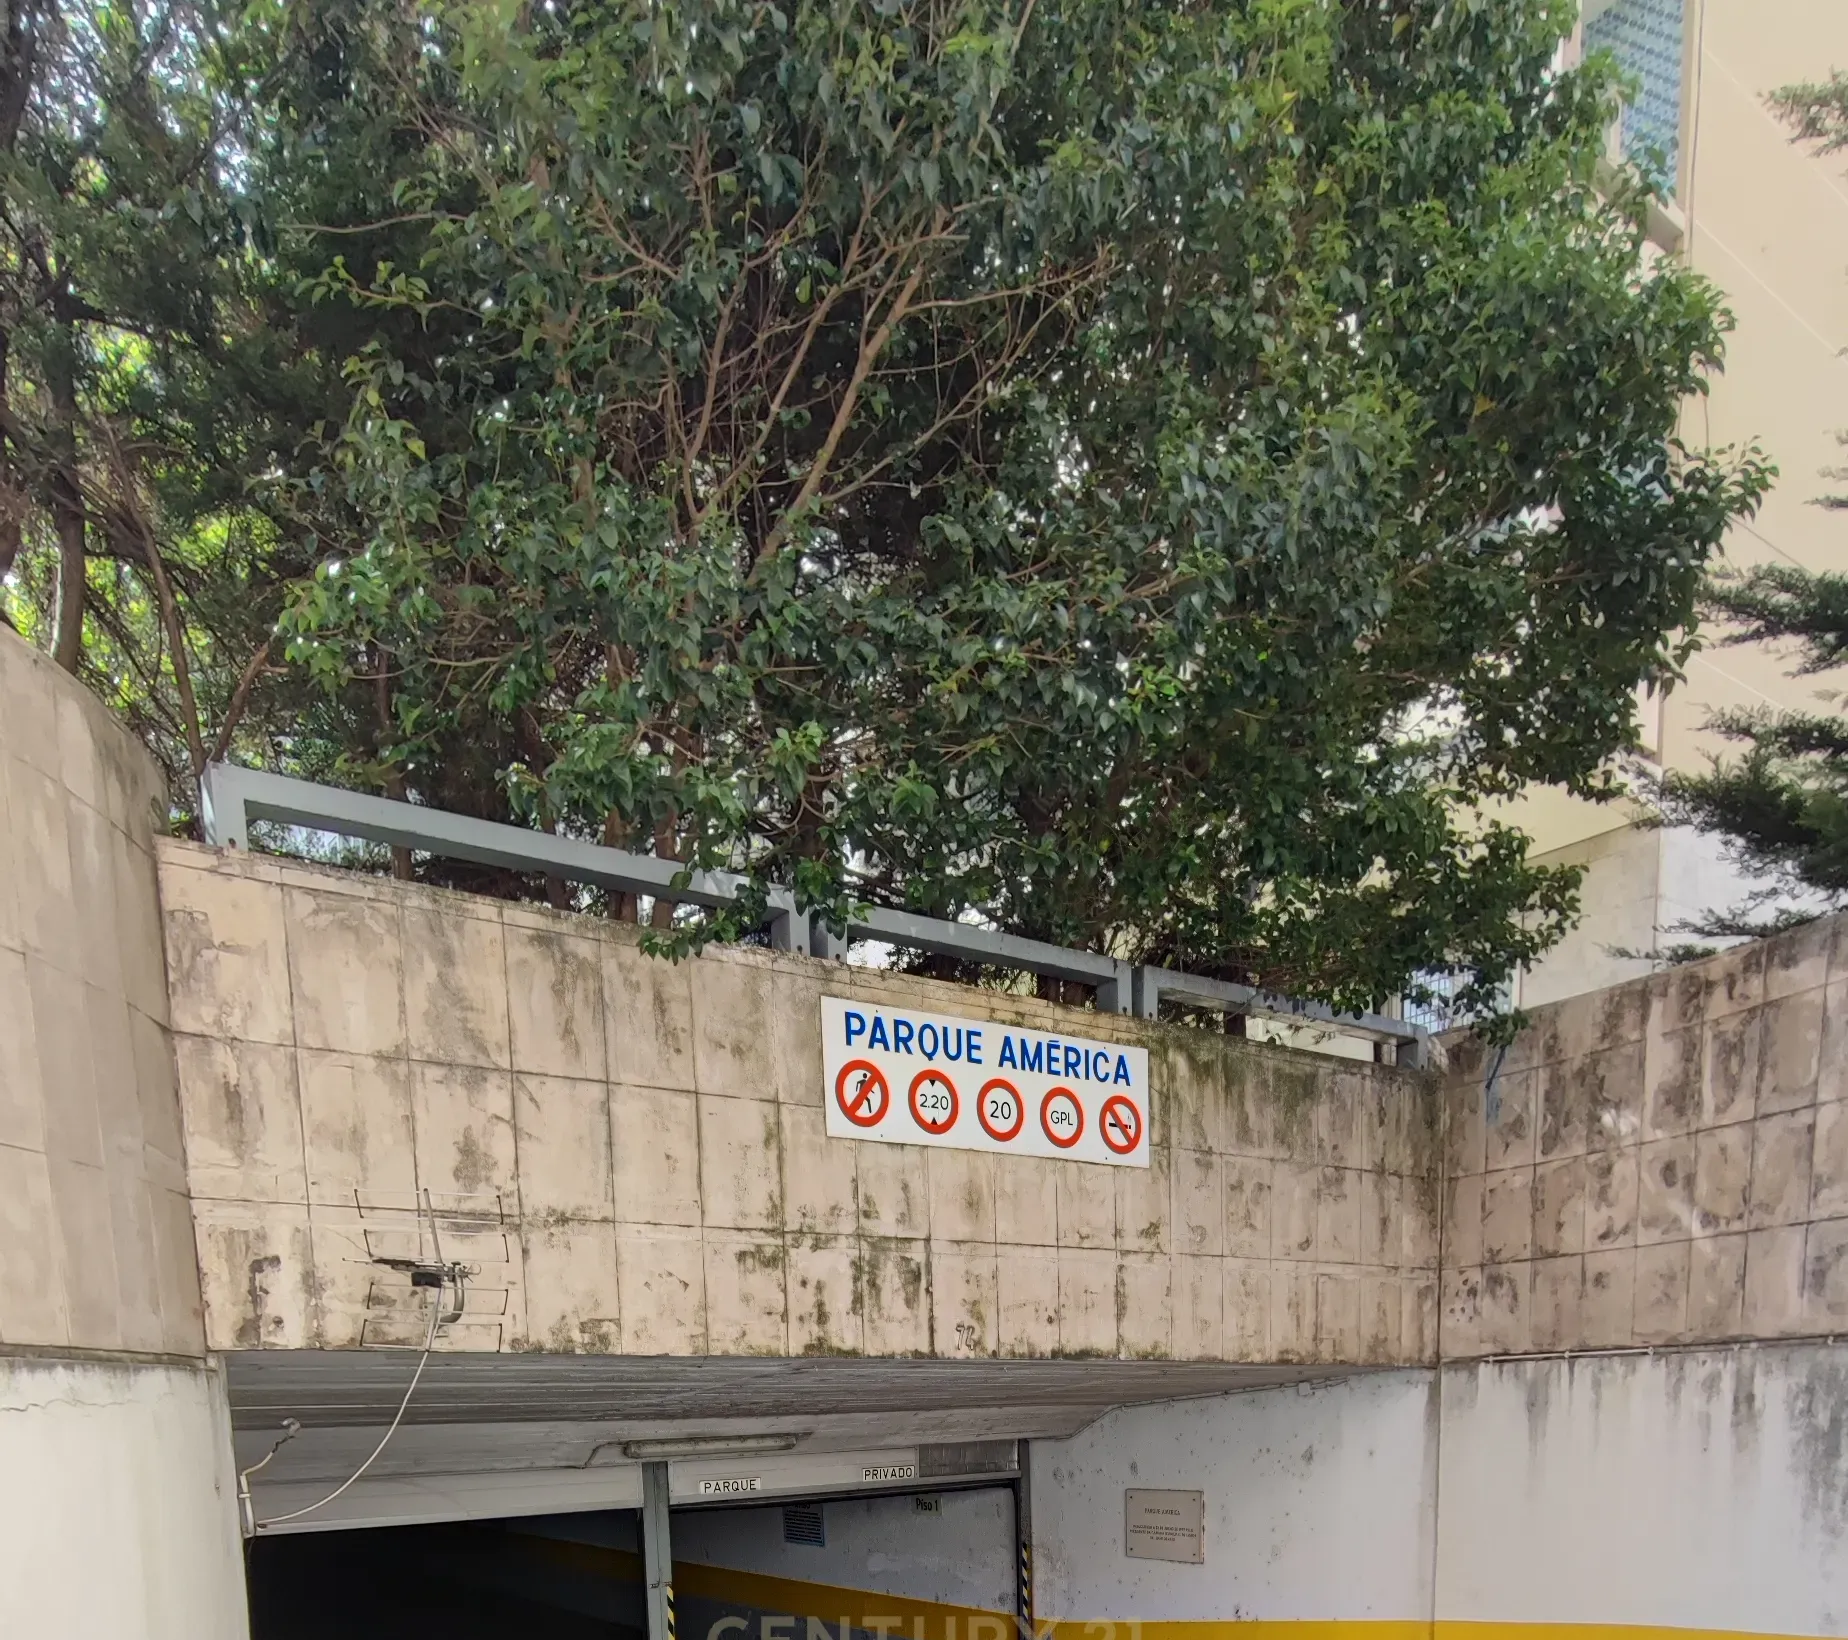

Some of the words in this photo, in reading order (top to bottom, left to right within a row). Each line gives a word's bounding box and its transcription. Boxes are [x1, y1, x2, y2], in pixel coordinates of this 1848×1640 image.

[844, 1011, 983, 1064] PARQUE
[998, 1036, 1131, 1087] AMÉRICA
[919, 1093, 949, 1111] 2.20
[989, 1100, 1012, 1120] 20
[1050, 1110, 1074, 1127] GPL
[704, 1479, 757, 1493] PARQUE
[864, 1467, 913, 1481] PRIVADO
[916, 1497, 933, 1511] Piso
[934, 1499, 939, 1511] 1
